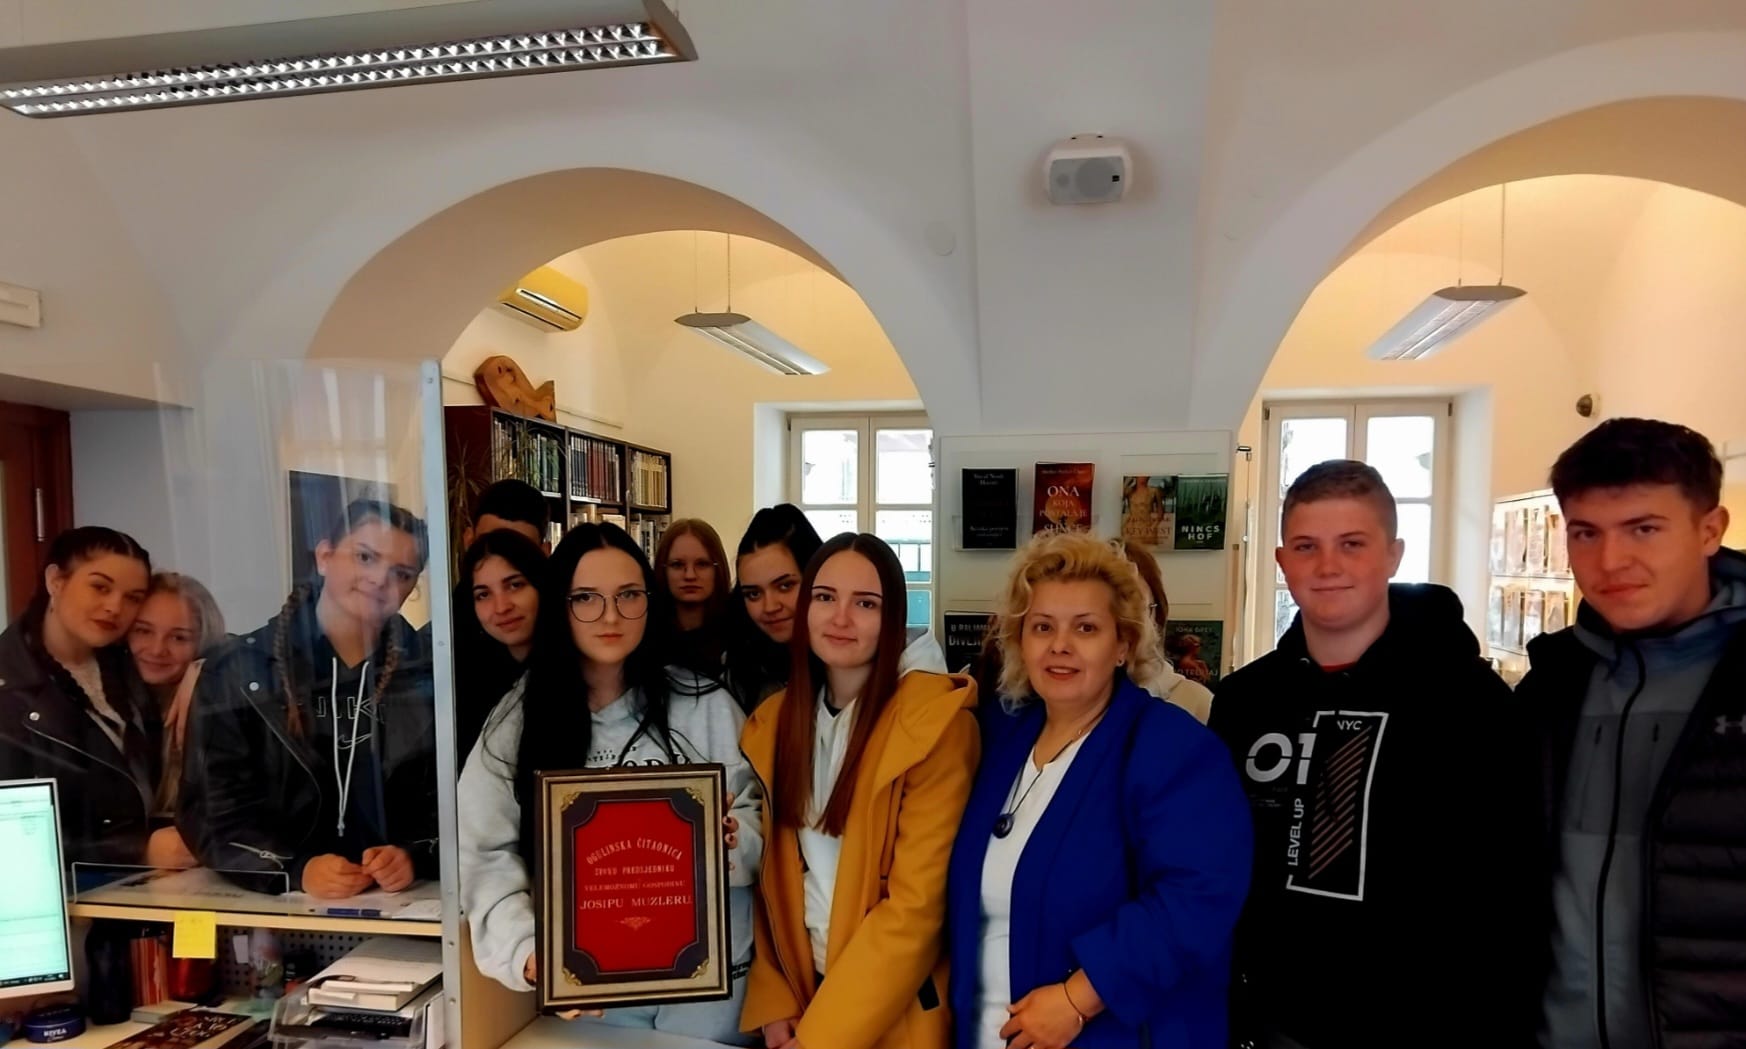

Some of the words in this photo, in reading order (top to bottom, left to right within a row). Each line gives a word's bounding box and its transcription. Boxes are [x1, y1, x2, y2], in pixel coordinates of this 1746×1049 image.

[1047, 485, 1080, 497] ONA
[1181, 525, 1220, 533] NINCS
[1336, 719, 1363, 730] NYC
[1293, 798, 1304, 818] UP
[637, 836, 683, 861] ČITAONICA
[1287, 821, 1303, 866] LEVEL
[579, 897, 624, 910] JOSIPU
[43, 1027, 67, 1037] NIVEA
